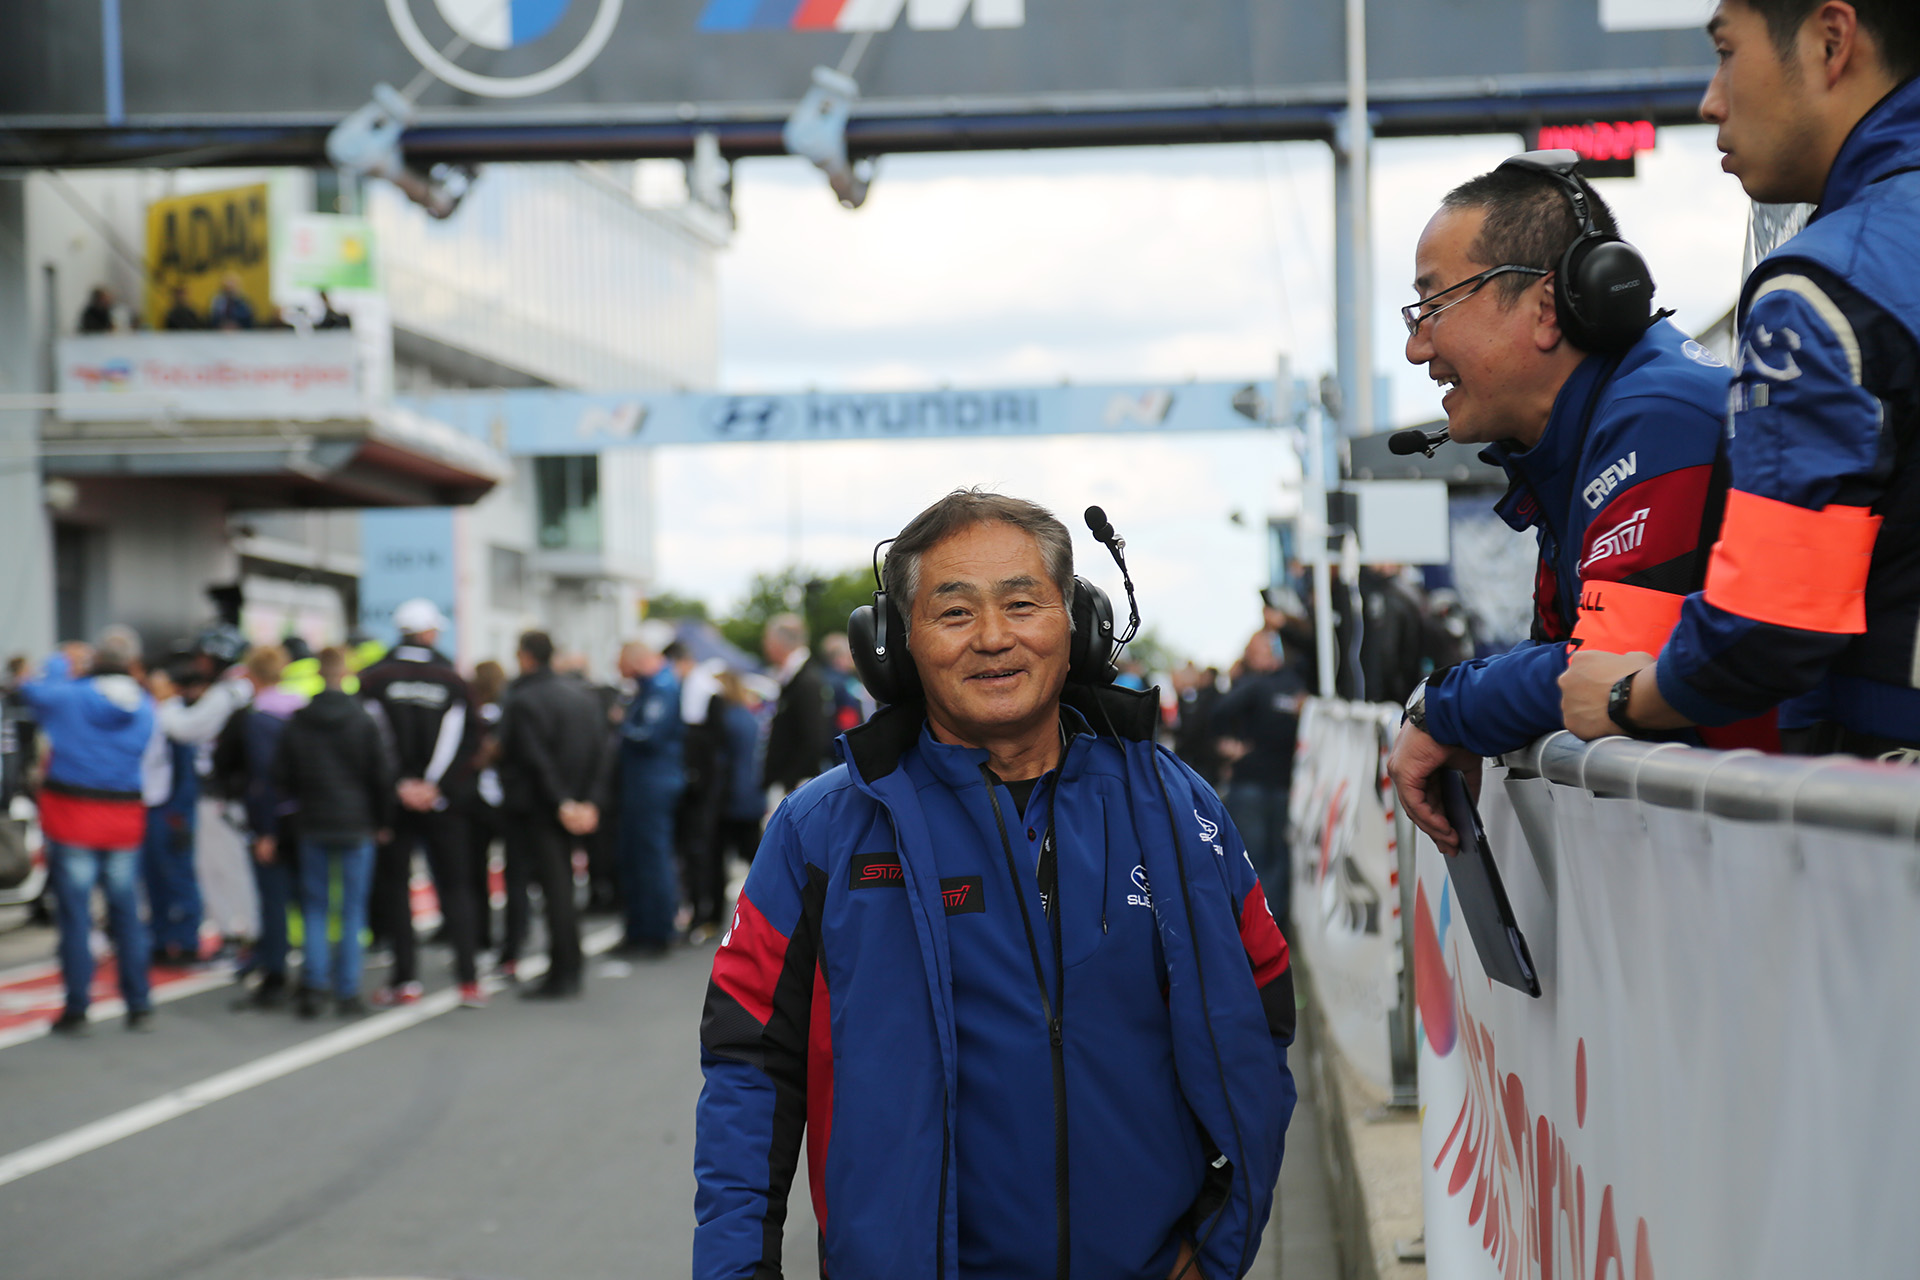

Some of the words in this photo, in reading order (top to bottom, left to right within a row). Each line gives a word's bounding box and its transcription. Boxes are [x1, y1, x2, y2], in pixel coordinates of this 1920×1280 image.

[1611, 280, 1640, 292] KENWOOD
[807, 391, 1040, 432] HYUNDAI
[1583, 451, 1637, 509] CREW
